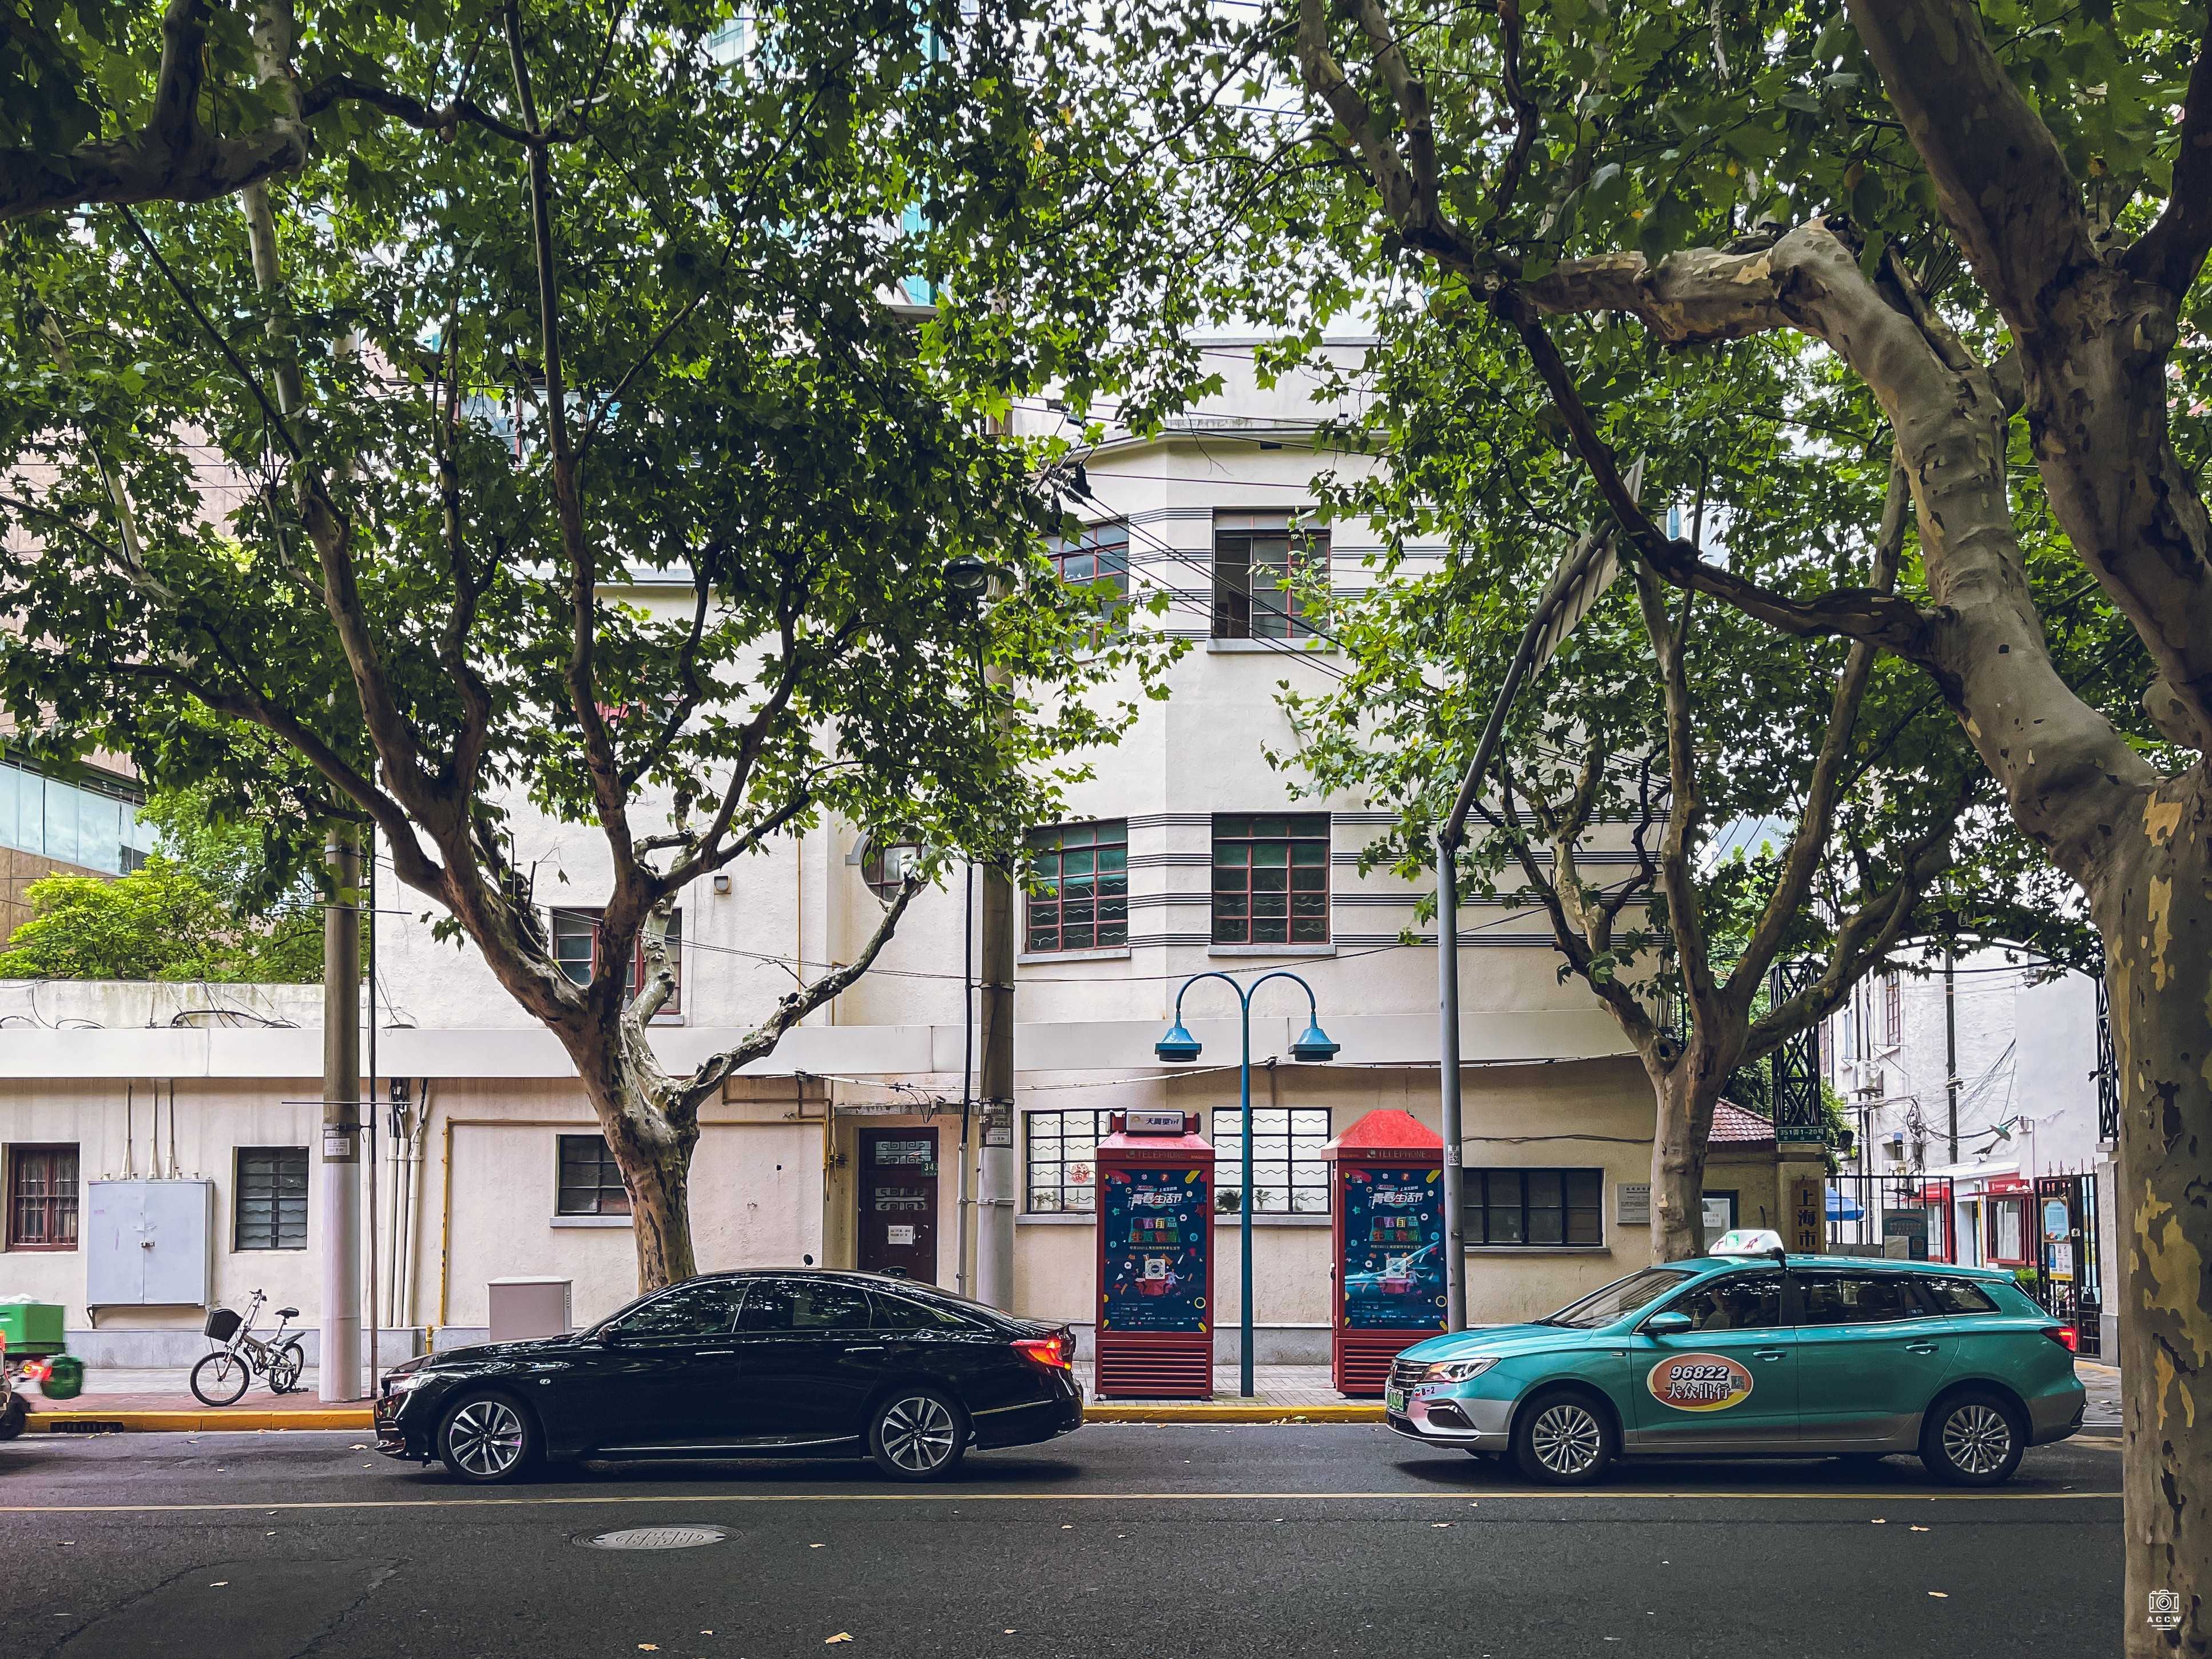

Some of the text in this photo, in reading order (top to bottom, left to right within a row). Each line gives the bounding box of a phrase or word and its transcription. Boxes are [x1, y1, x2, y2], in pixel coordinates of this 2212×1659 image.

[1138, 1150, 1186, 1158] TELEPHONE
[1378, 1149, 1427, 1158] TELEPHONE
[1796, 1189, 1818, 1253] 上海市
[1670, 1365, 1729, 1380] 96822
[1421, 1386, 1435, 1396] B-2
[1666, 1382, 1731, 1400] 大众出行
